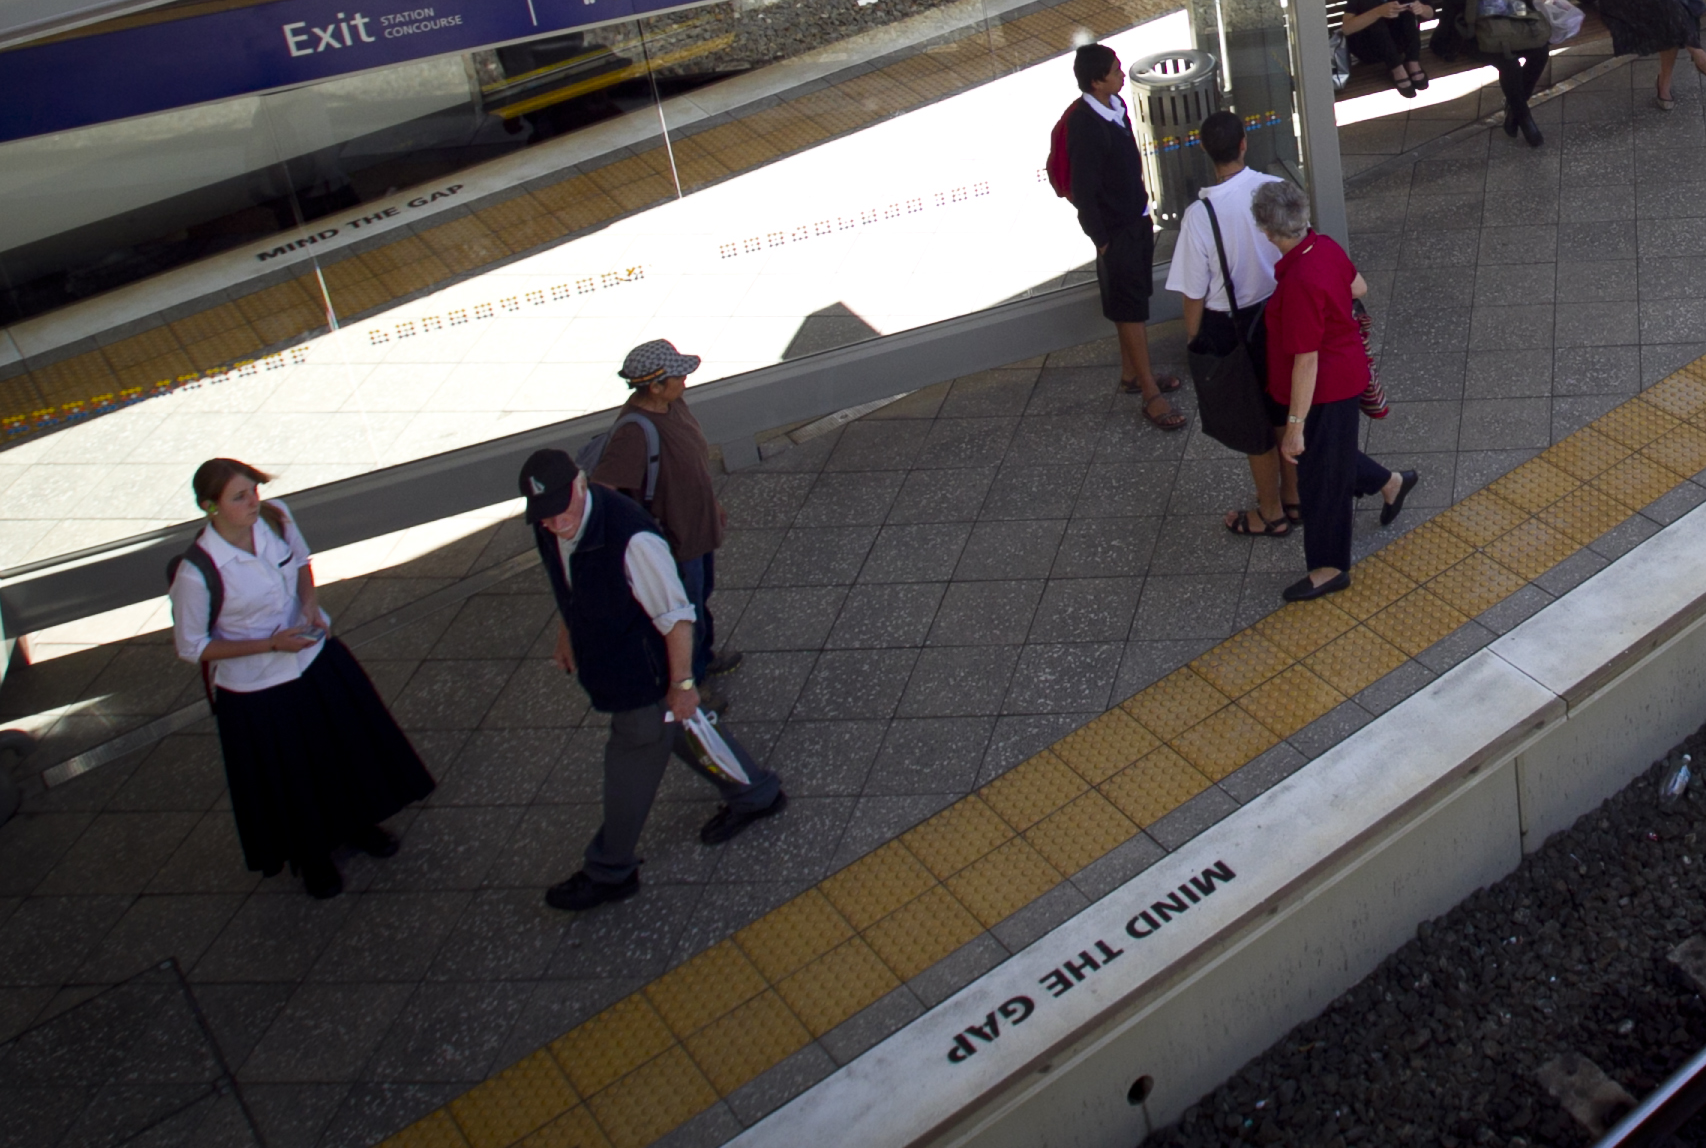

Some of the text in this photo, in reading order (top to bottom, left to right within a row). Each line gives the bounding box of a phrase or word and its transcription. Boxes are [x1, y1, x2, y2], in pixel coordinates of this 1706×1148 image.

[283, 12, 375, 57] Exit
[380, 7, 435, 27] STATION
[384, 14, 464, 39] CONCOURSE
[255, 184, 464, 262] MIND THE GAP
[947, 859, 1237, 1063] MIND THE GAP
